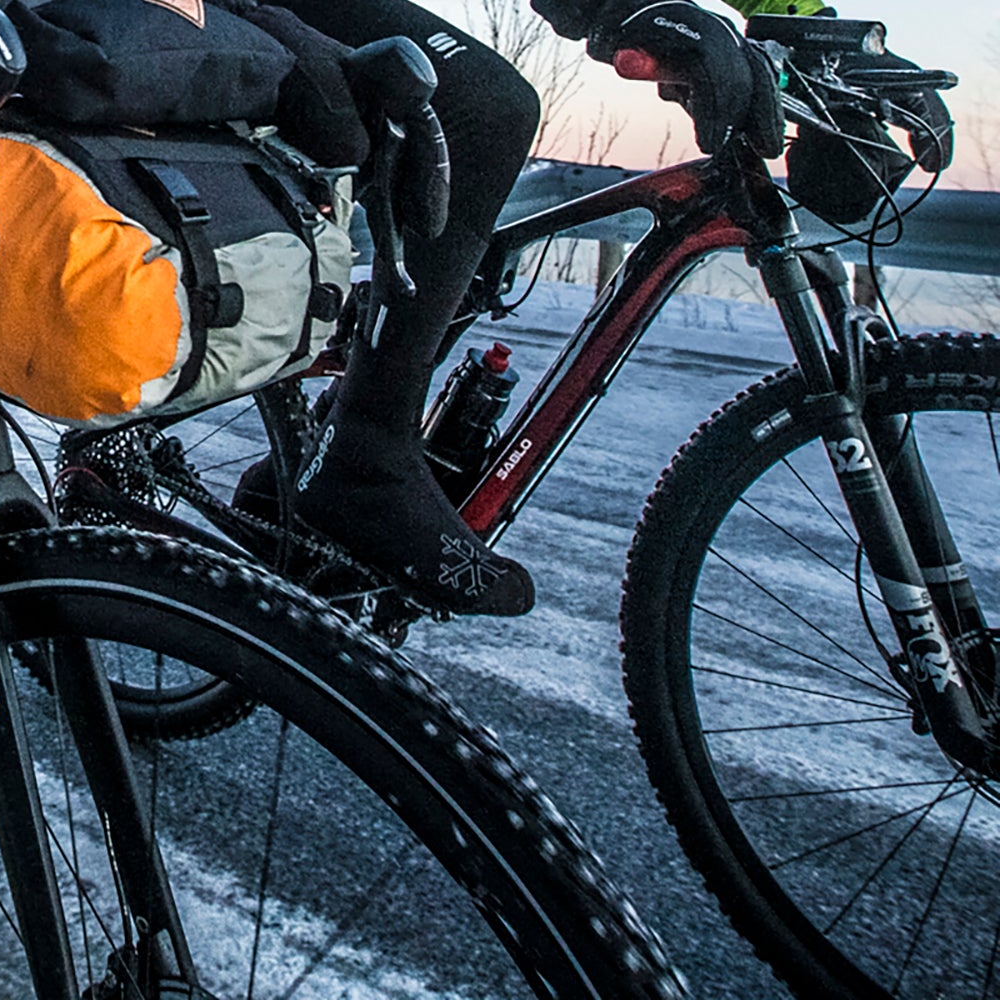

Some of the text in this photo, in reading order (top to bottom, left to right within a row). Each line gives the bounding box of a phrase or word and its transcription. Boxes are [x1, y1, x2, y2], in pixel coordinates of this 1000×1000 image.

[297, 425, 335, 492] GripGrab
[496, 438, 533, 481] SABLO
[906, 610, 963, 693] FOX
